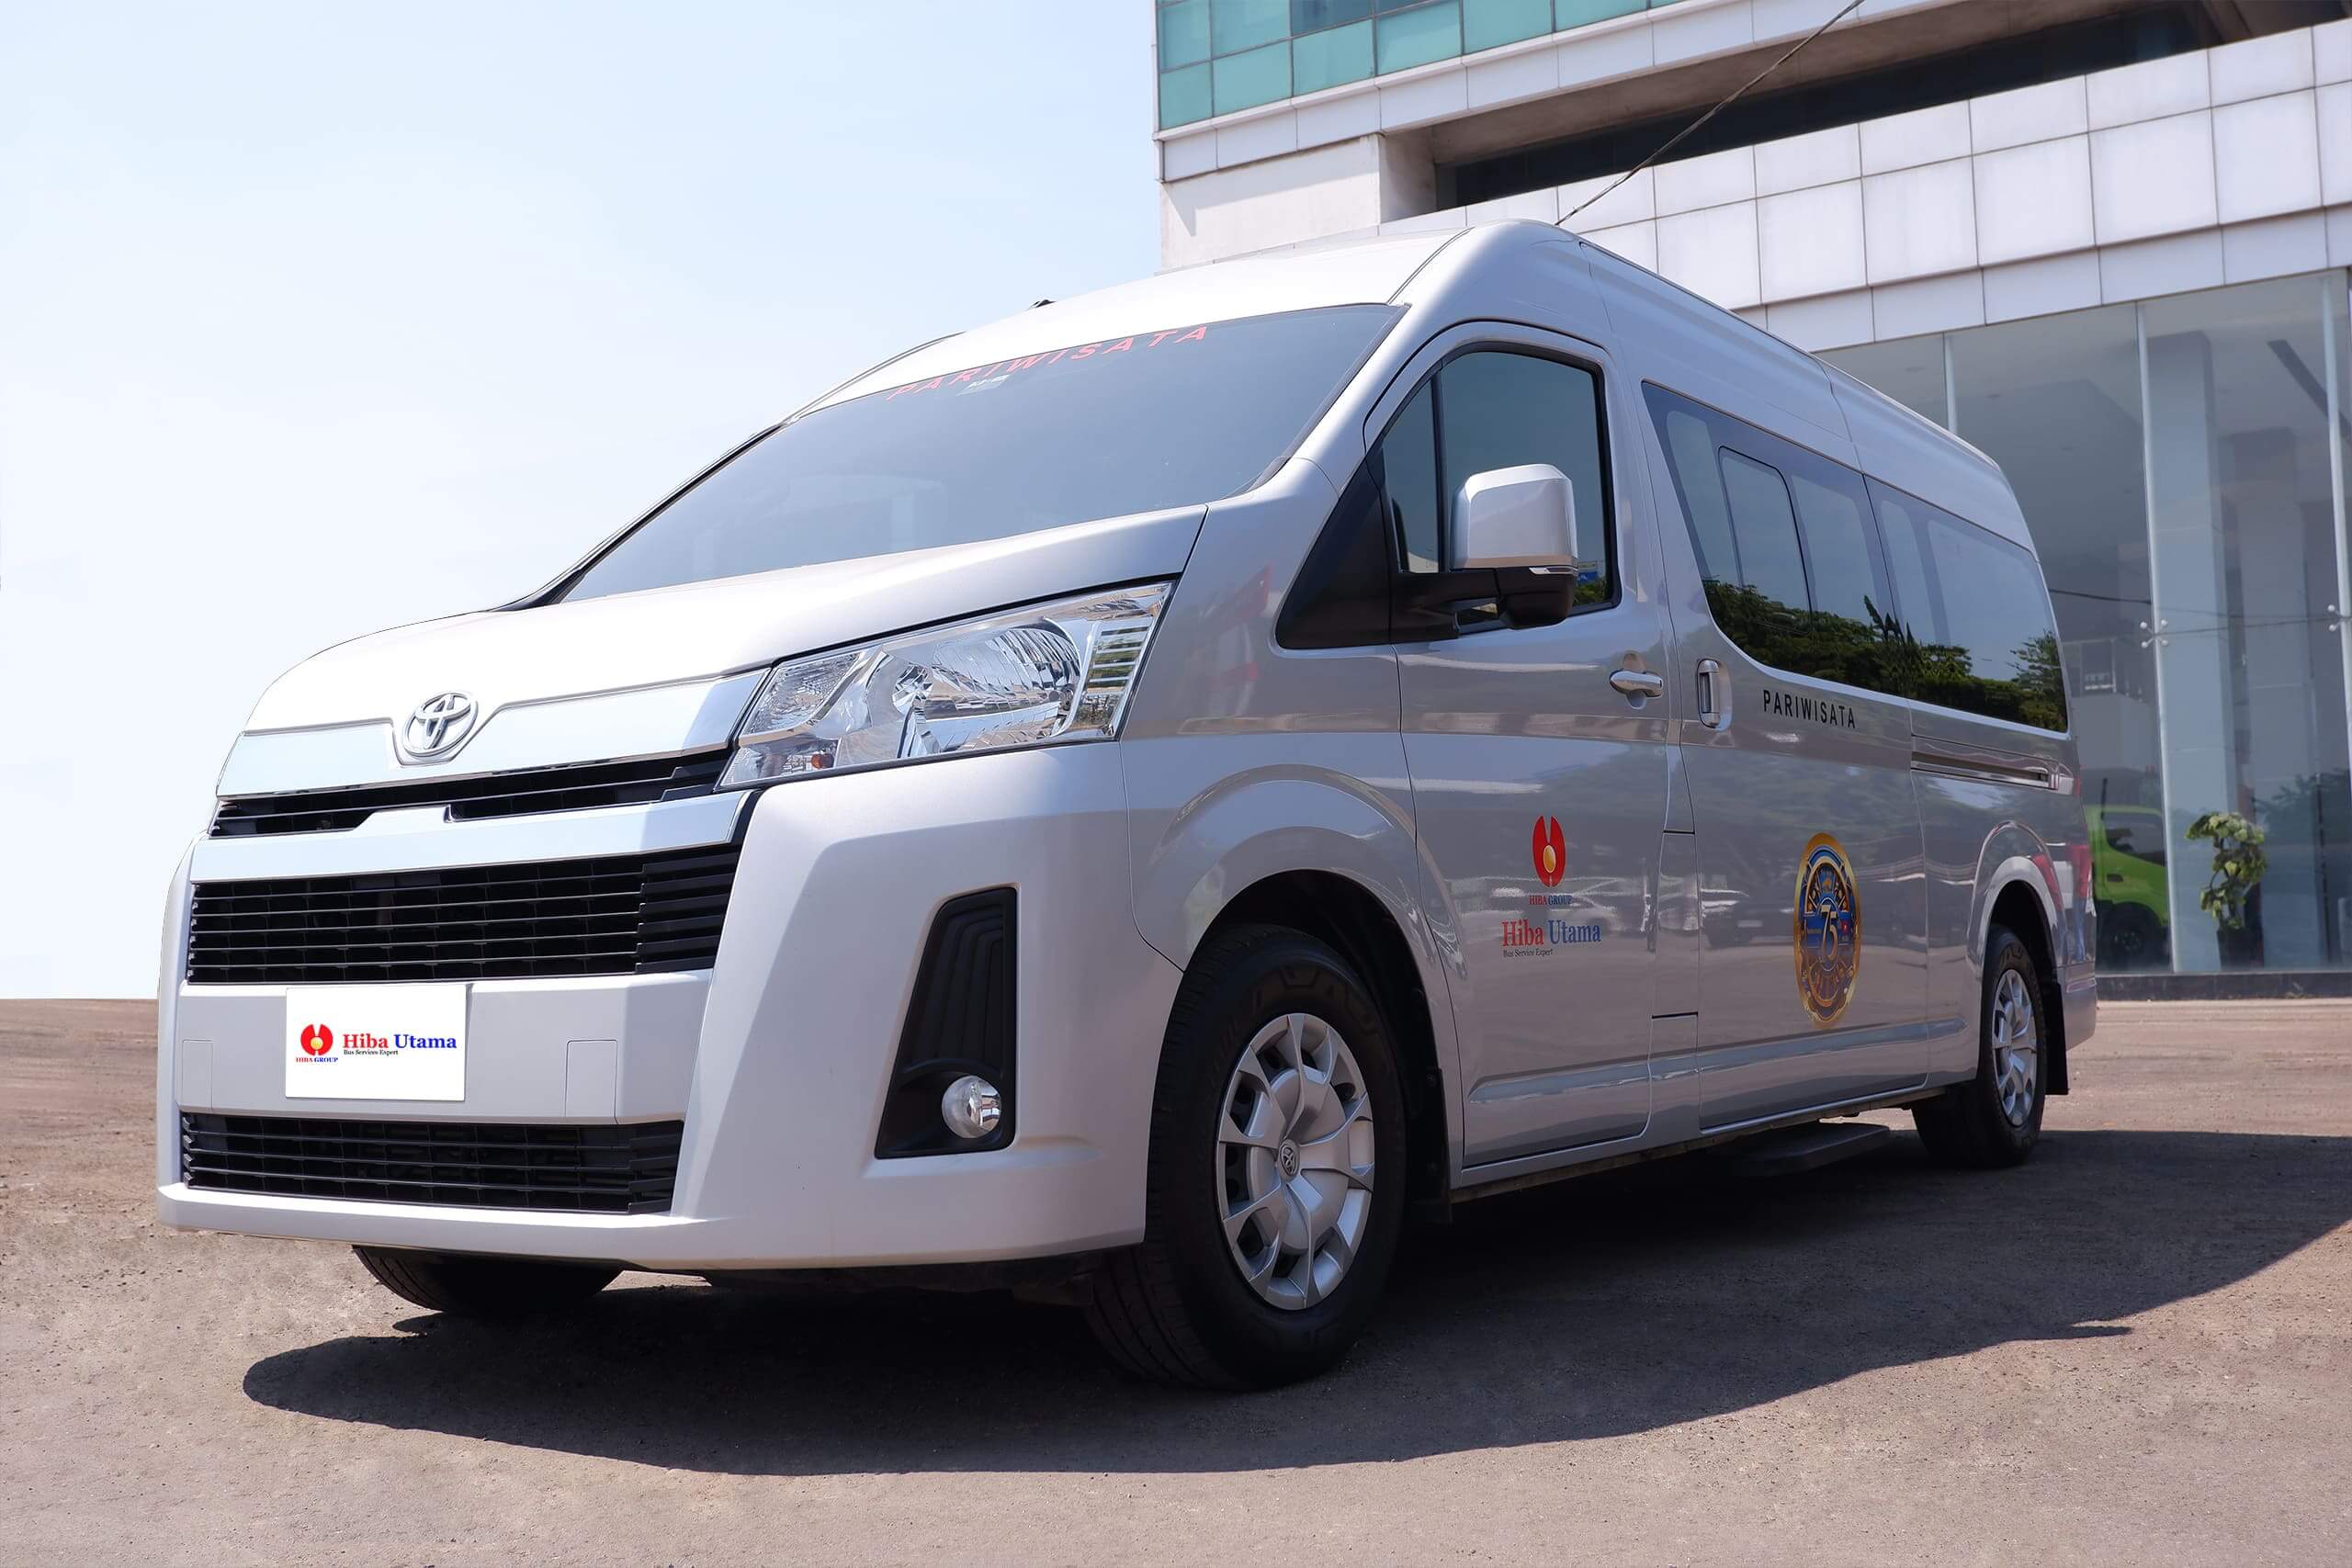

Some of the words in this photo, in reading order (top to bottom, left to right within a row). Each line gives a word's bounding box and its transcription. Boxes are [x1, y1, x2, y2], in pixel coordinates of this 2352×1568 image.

[886, 326, 1207, 401] PARIWISATA
[1763, 689, 1856, 728] PARIWISATA
[1529, 896, 1547, 906] HIBA
[1548, 895, 1573, 905] GROUP
[1502, 919, 1544, 947] Hiba
[1548, 919, 1601, 945] Utama
[1503, 949, 1514, 958] Bus
[1535, 947, 1553, 956] Expert
[343, 1033, 389, 1049] Hiba
[393, 1034, 457, 1049] Utama
